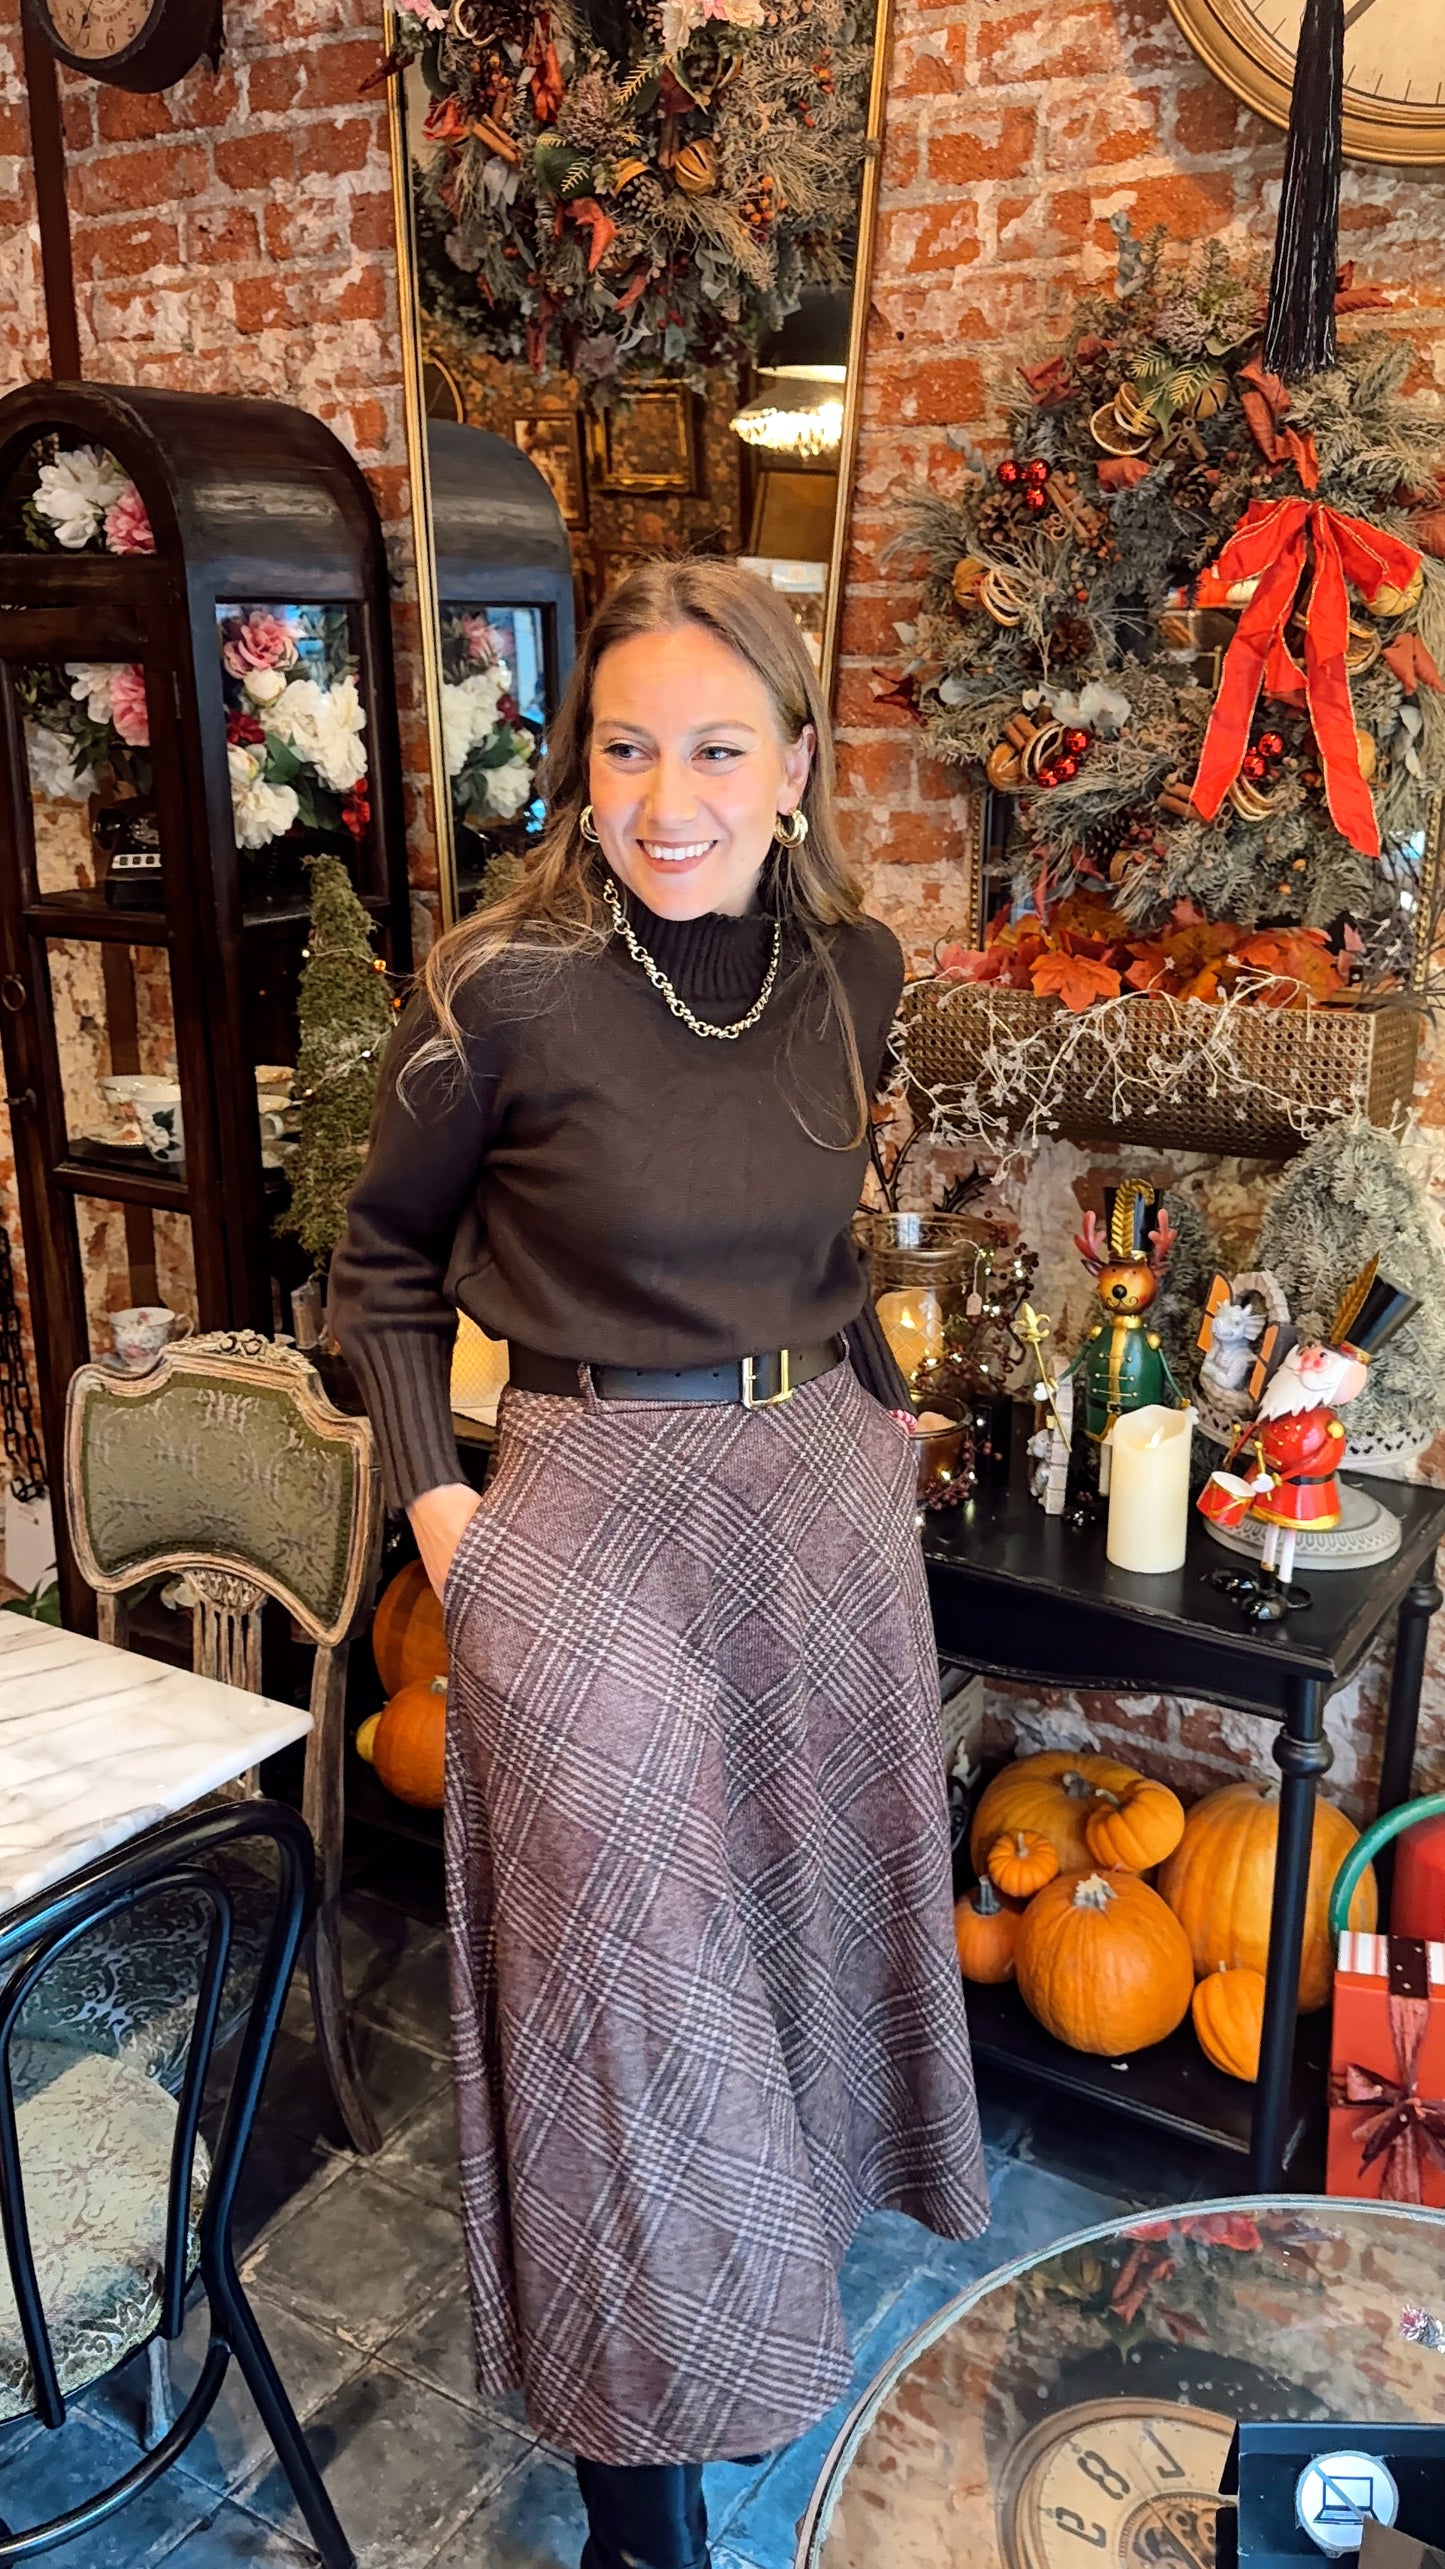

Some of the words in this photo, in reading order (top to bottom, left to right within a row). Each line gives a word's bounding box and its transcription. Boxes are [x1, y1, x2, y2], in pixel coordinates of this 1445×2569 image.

[66, 7, 76, 28] 8
[127, 18, 136, 38] 5
[106, 28, 115, 50] 6
